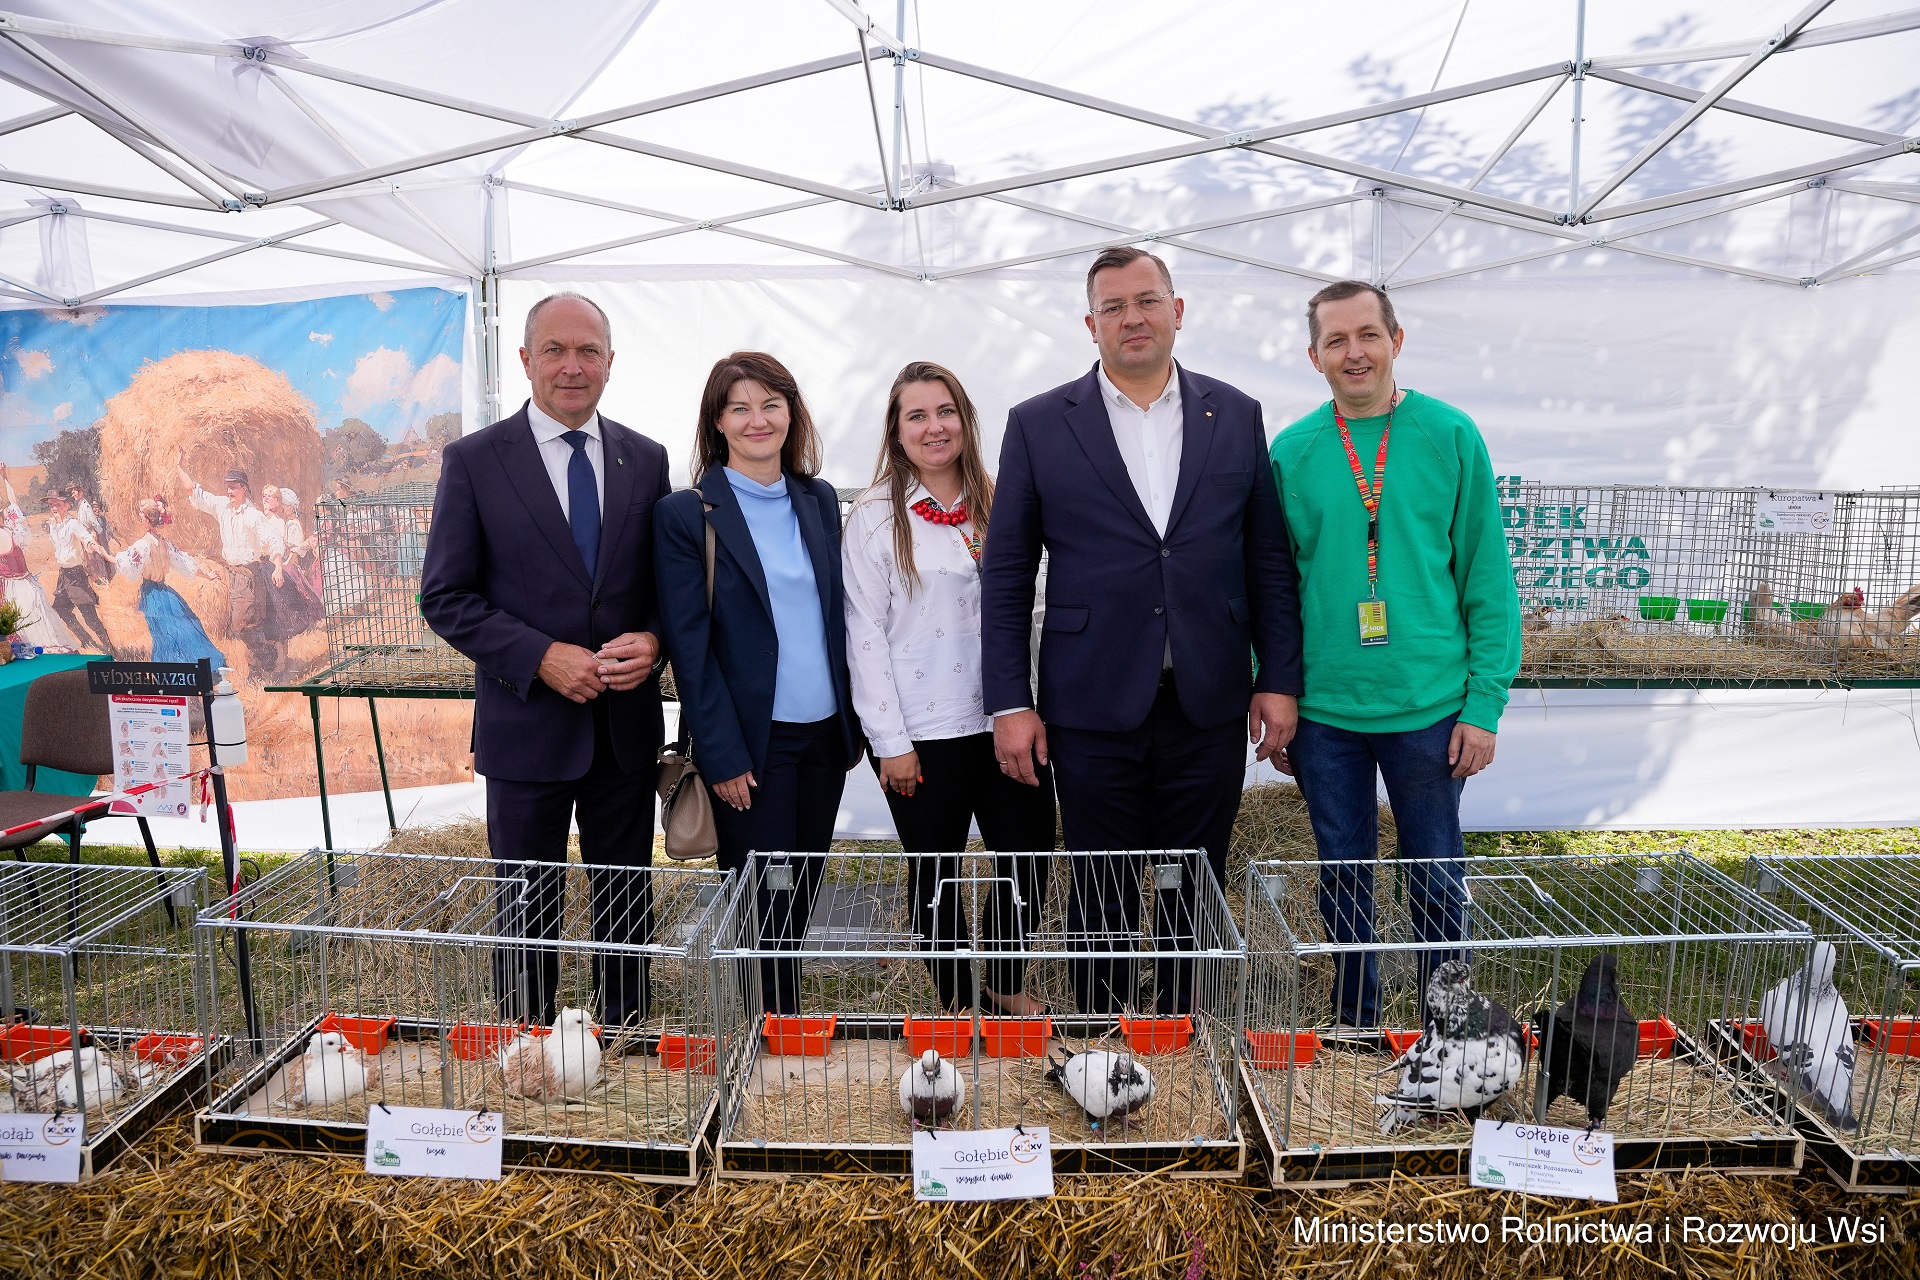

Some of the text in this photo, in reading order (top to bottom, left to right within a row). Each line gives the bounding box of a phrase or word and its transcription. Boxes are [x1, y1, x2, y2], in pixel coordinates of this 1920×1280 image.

[1501, 506, 1587, 529] DEK
[100, 669, 196, 686] DEZYNFEKCJA
[0, 1127, 35, 1142] ołąb
[410, 1122, 464, 1137] Gołębie
[1515, 1126, 1570, 1144] Gołębie
[954, 1148, 1009, 1164] Gołębie
[1508, 1160, 1541, 1170] Francszek
